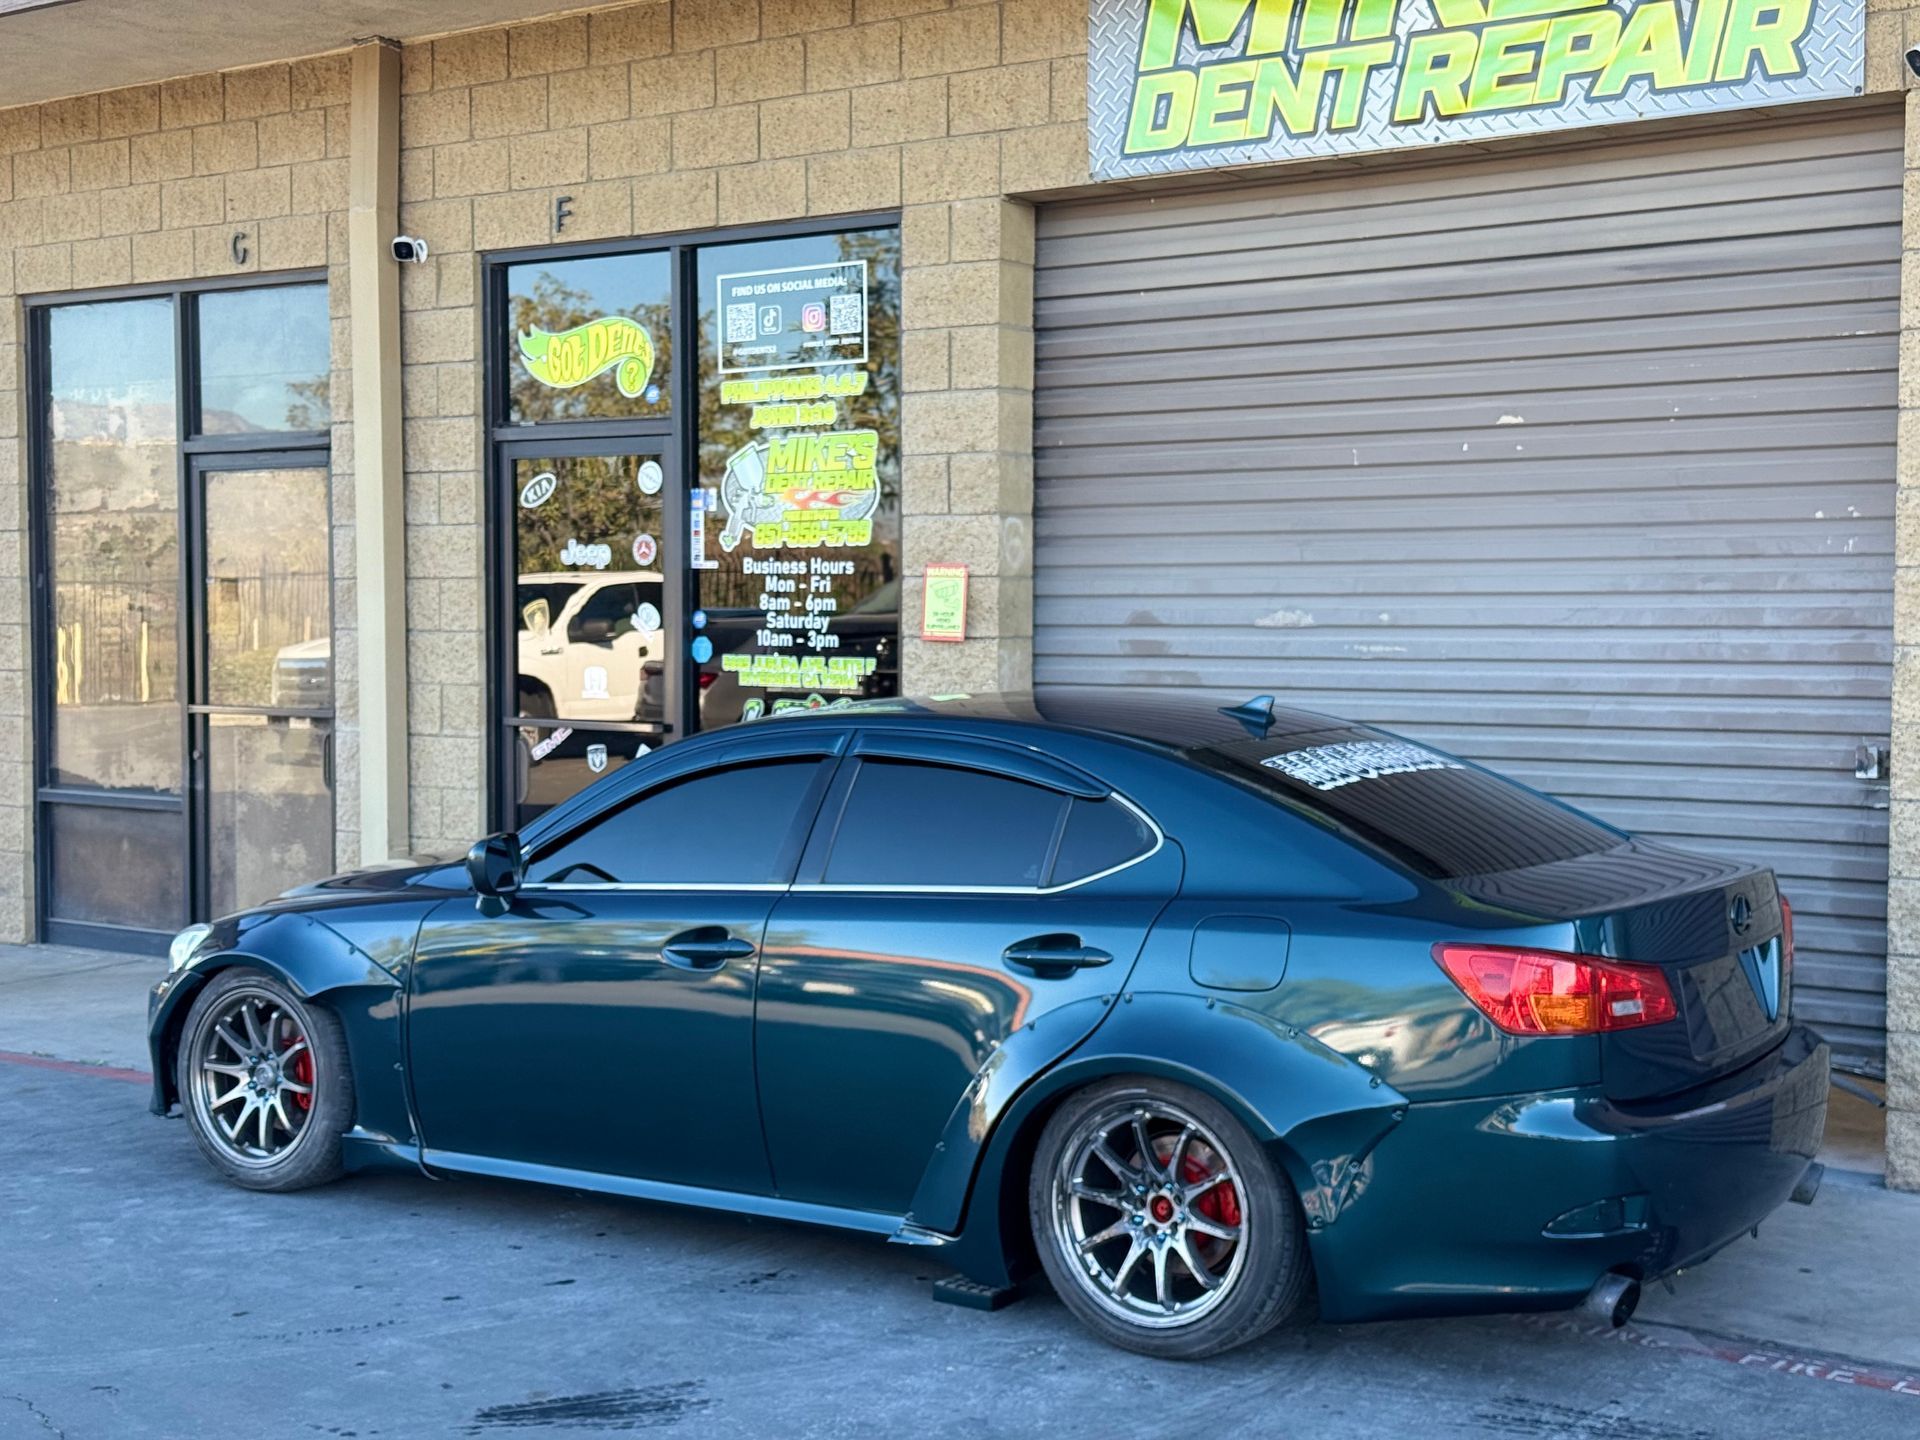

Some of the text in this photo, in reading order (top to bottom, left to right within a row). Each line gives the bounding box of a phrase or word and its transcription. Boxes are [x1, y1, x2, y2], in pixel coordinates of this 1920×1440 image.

[1125, 41, 1396, 154] DENT
[1394, 0, 1811, 122] REPAIR
[555, 196, 572, 233] F
[731, 285, 753, 297] FIND
[754, 283, 766, 295] US
[767, 282, 781, 293] ON
[781, 279, 814, 292] SOCIAL
[523, 475, 555, 505] KIA
[813, 470, 874, 490] REPAIR
[560, 538, 611, 569] Jeep
[743, 557, 854, 575] Business Hours
[765, 576, 795, 593] Mon
[810, 576, 831, 593] Fri
[759, 594, 790, 610] 8am
[805, 595, 837, 614] 6pm
[766, 612, 830, 633] Saturday
[756, 629, 793, 647] 10am
[807, 630, 839, 651] 3pm
